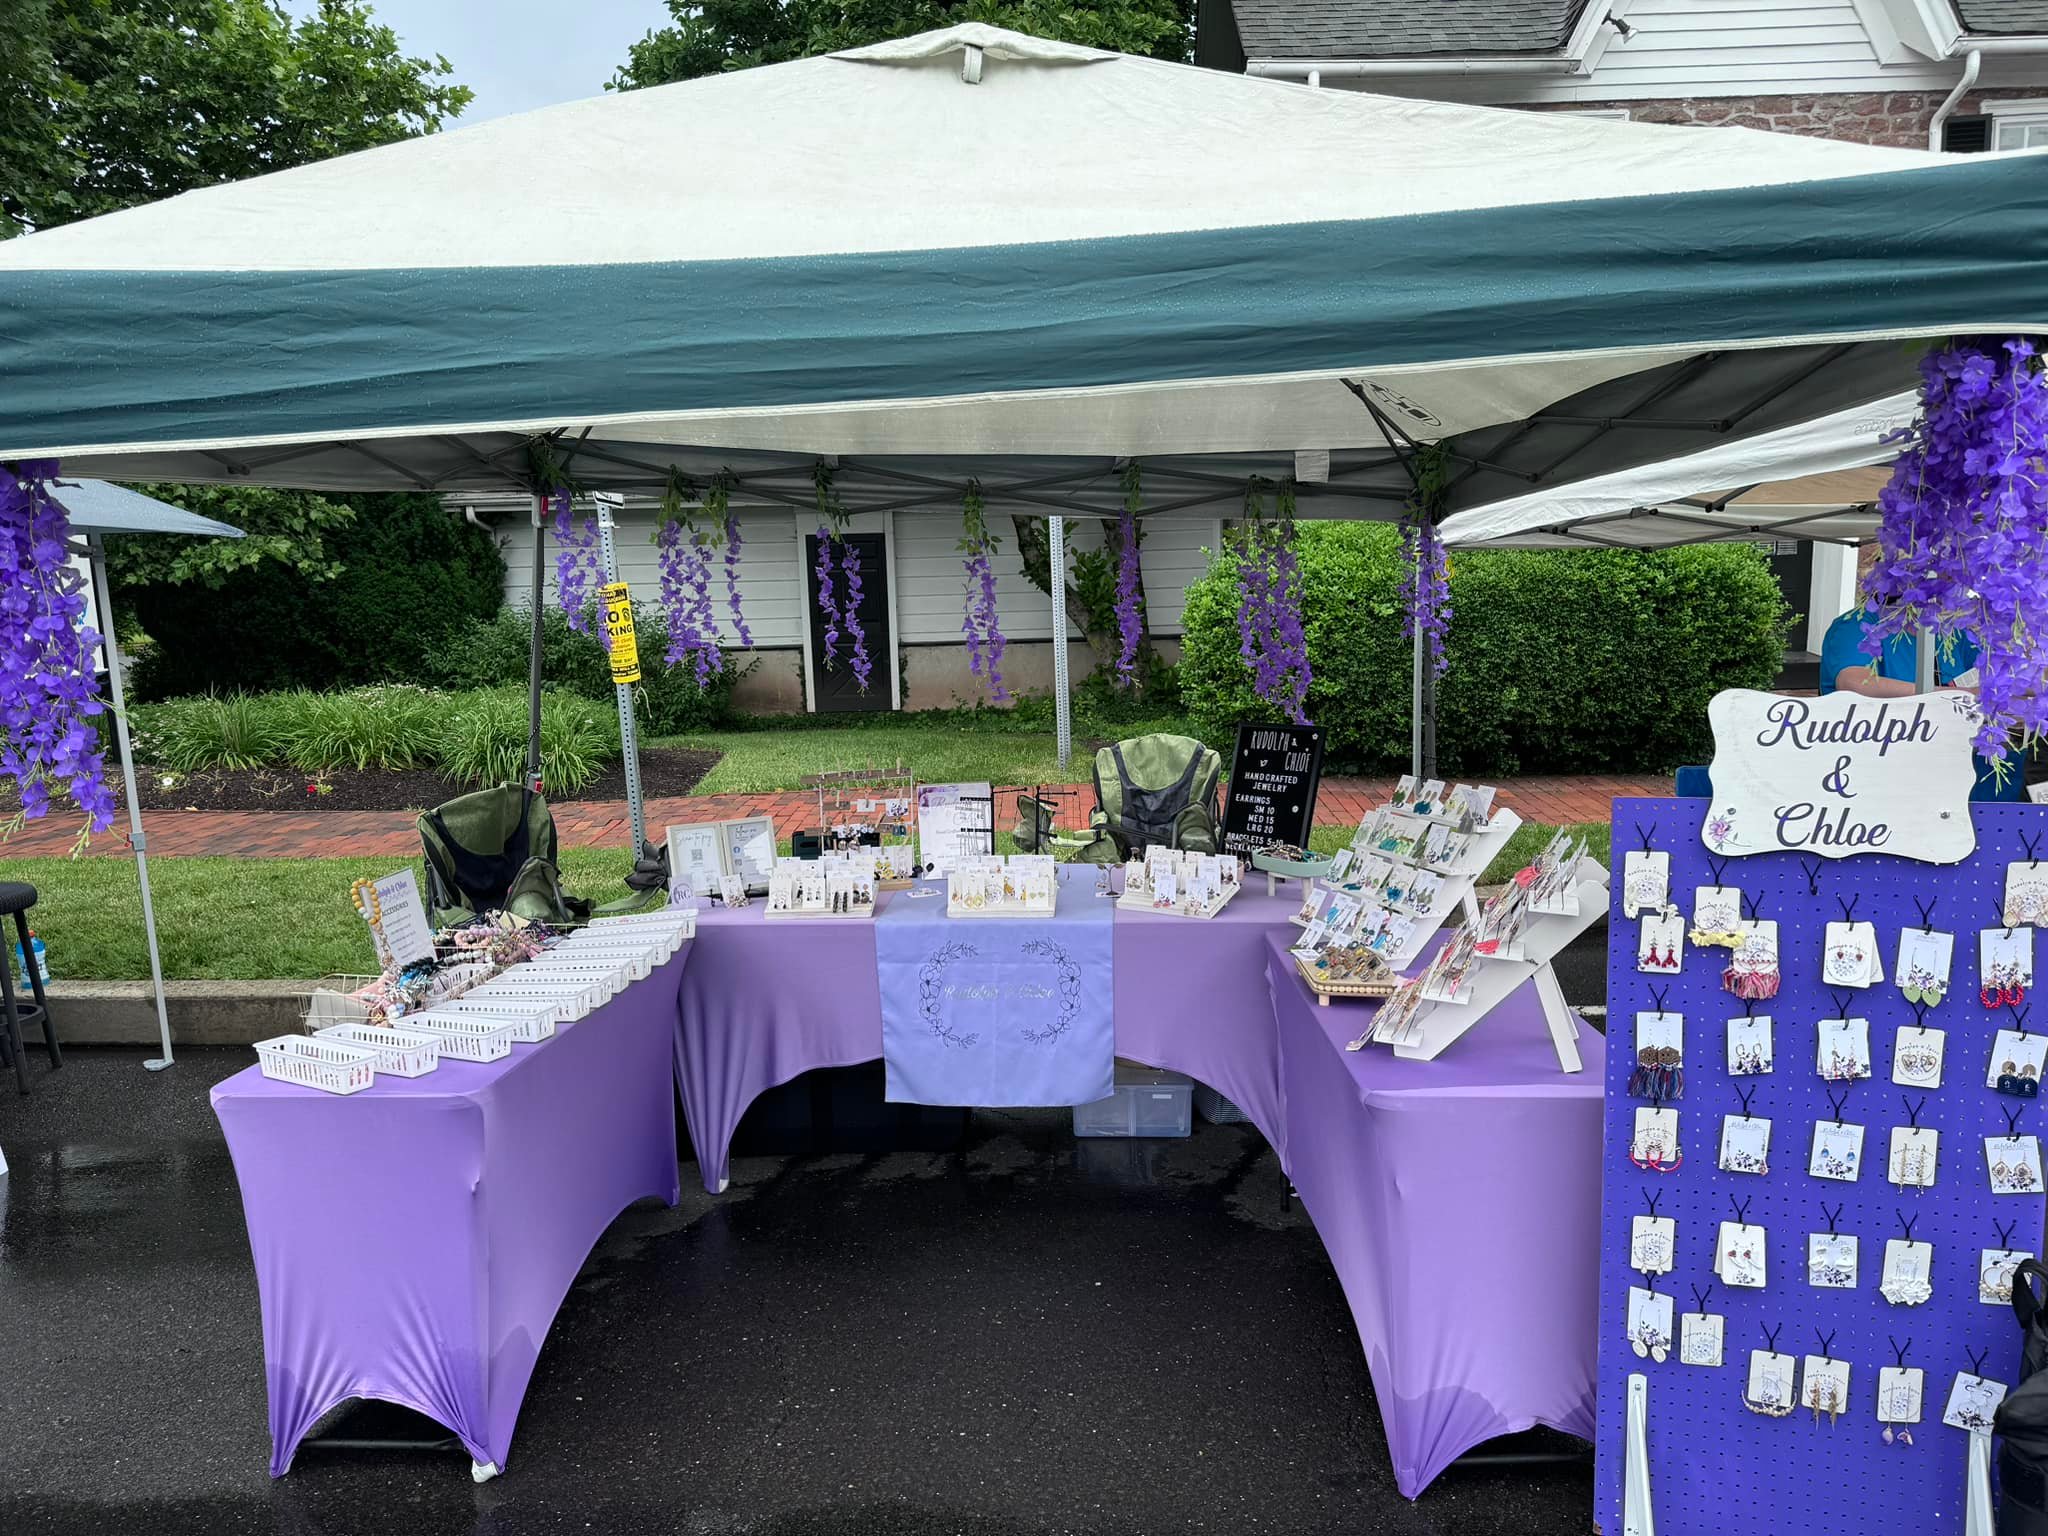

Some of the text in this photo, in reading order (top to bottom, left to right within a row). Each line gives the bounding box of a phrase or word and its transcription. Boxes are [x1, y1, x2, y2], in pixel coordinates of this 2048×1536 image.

[1757, 699, 1938, 756] Rudolph
[1250, 730, 1298, 752] RUDOLPH &
[1284, 751, 1311, 773] CHLOE
[1822, 755, 1857, 798] &
[1252, 782, 1287, 793] JEWELRY
[1235, 793, 1271, 805] EARRINGS
[1254, 805, 1275, 815] SM 10
[1246, 823, 1274, 834] LRG 20
[1265, 815, 1275, 825] 15
[1774, 802, 1892, 848] Chloe
